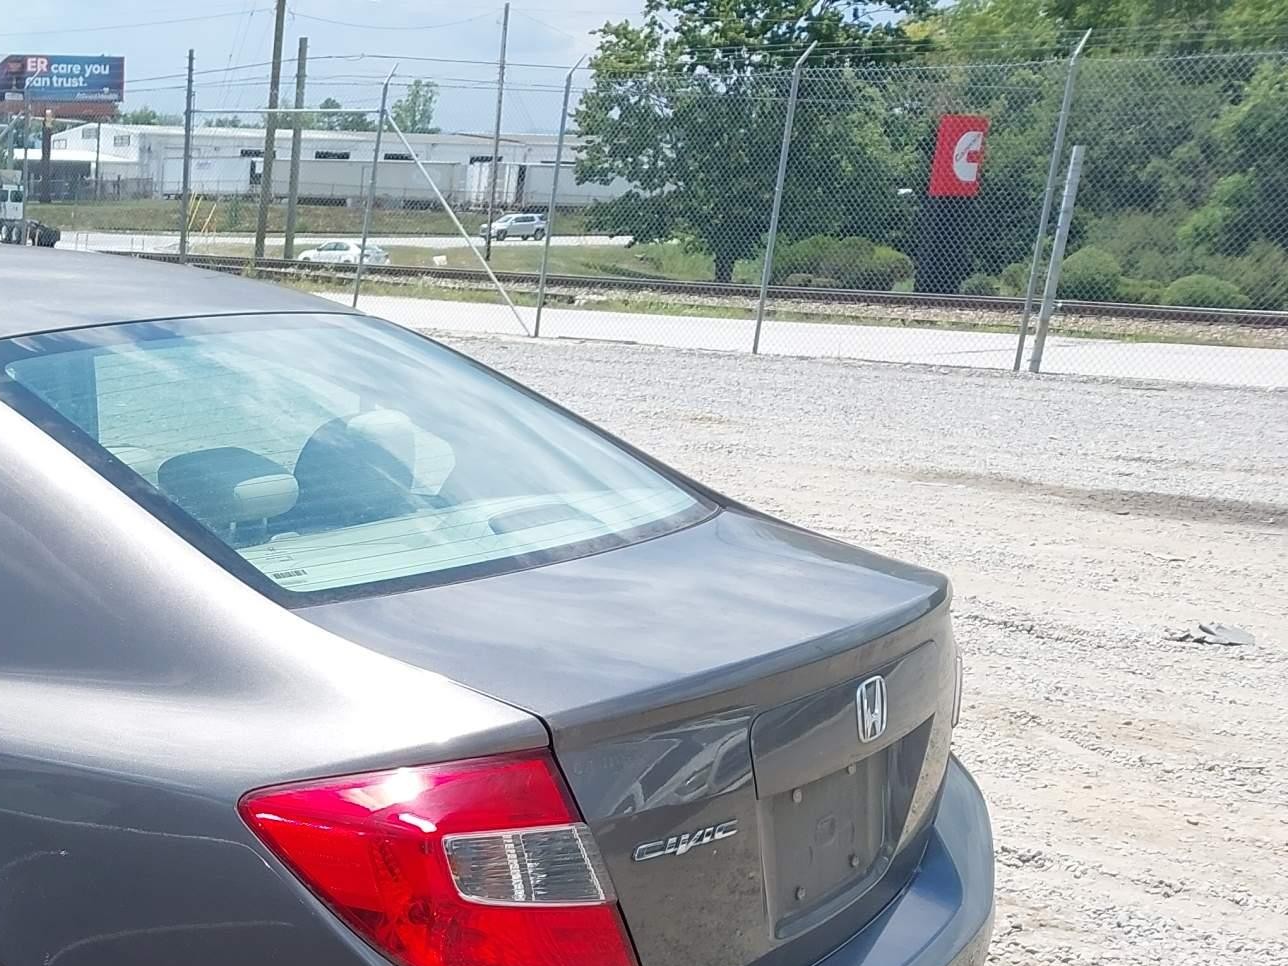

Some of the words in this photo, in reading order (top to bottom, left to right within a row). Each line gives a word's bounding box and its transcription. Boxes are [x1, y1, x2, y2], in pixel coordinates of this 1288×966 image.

[26, 57, 48, 72] ER
[51, 63, 81, 74] care
[85, 63, 110, 77] you
[26, 75, 50, 87] can
[52, 75, 87, 87] trust.
[632, 819, 739, 863] CIVIC
